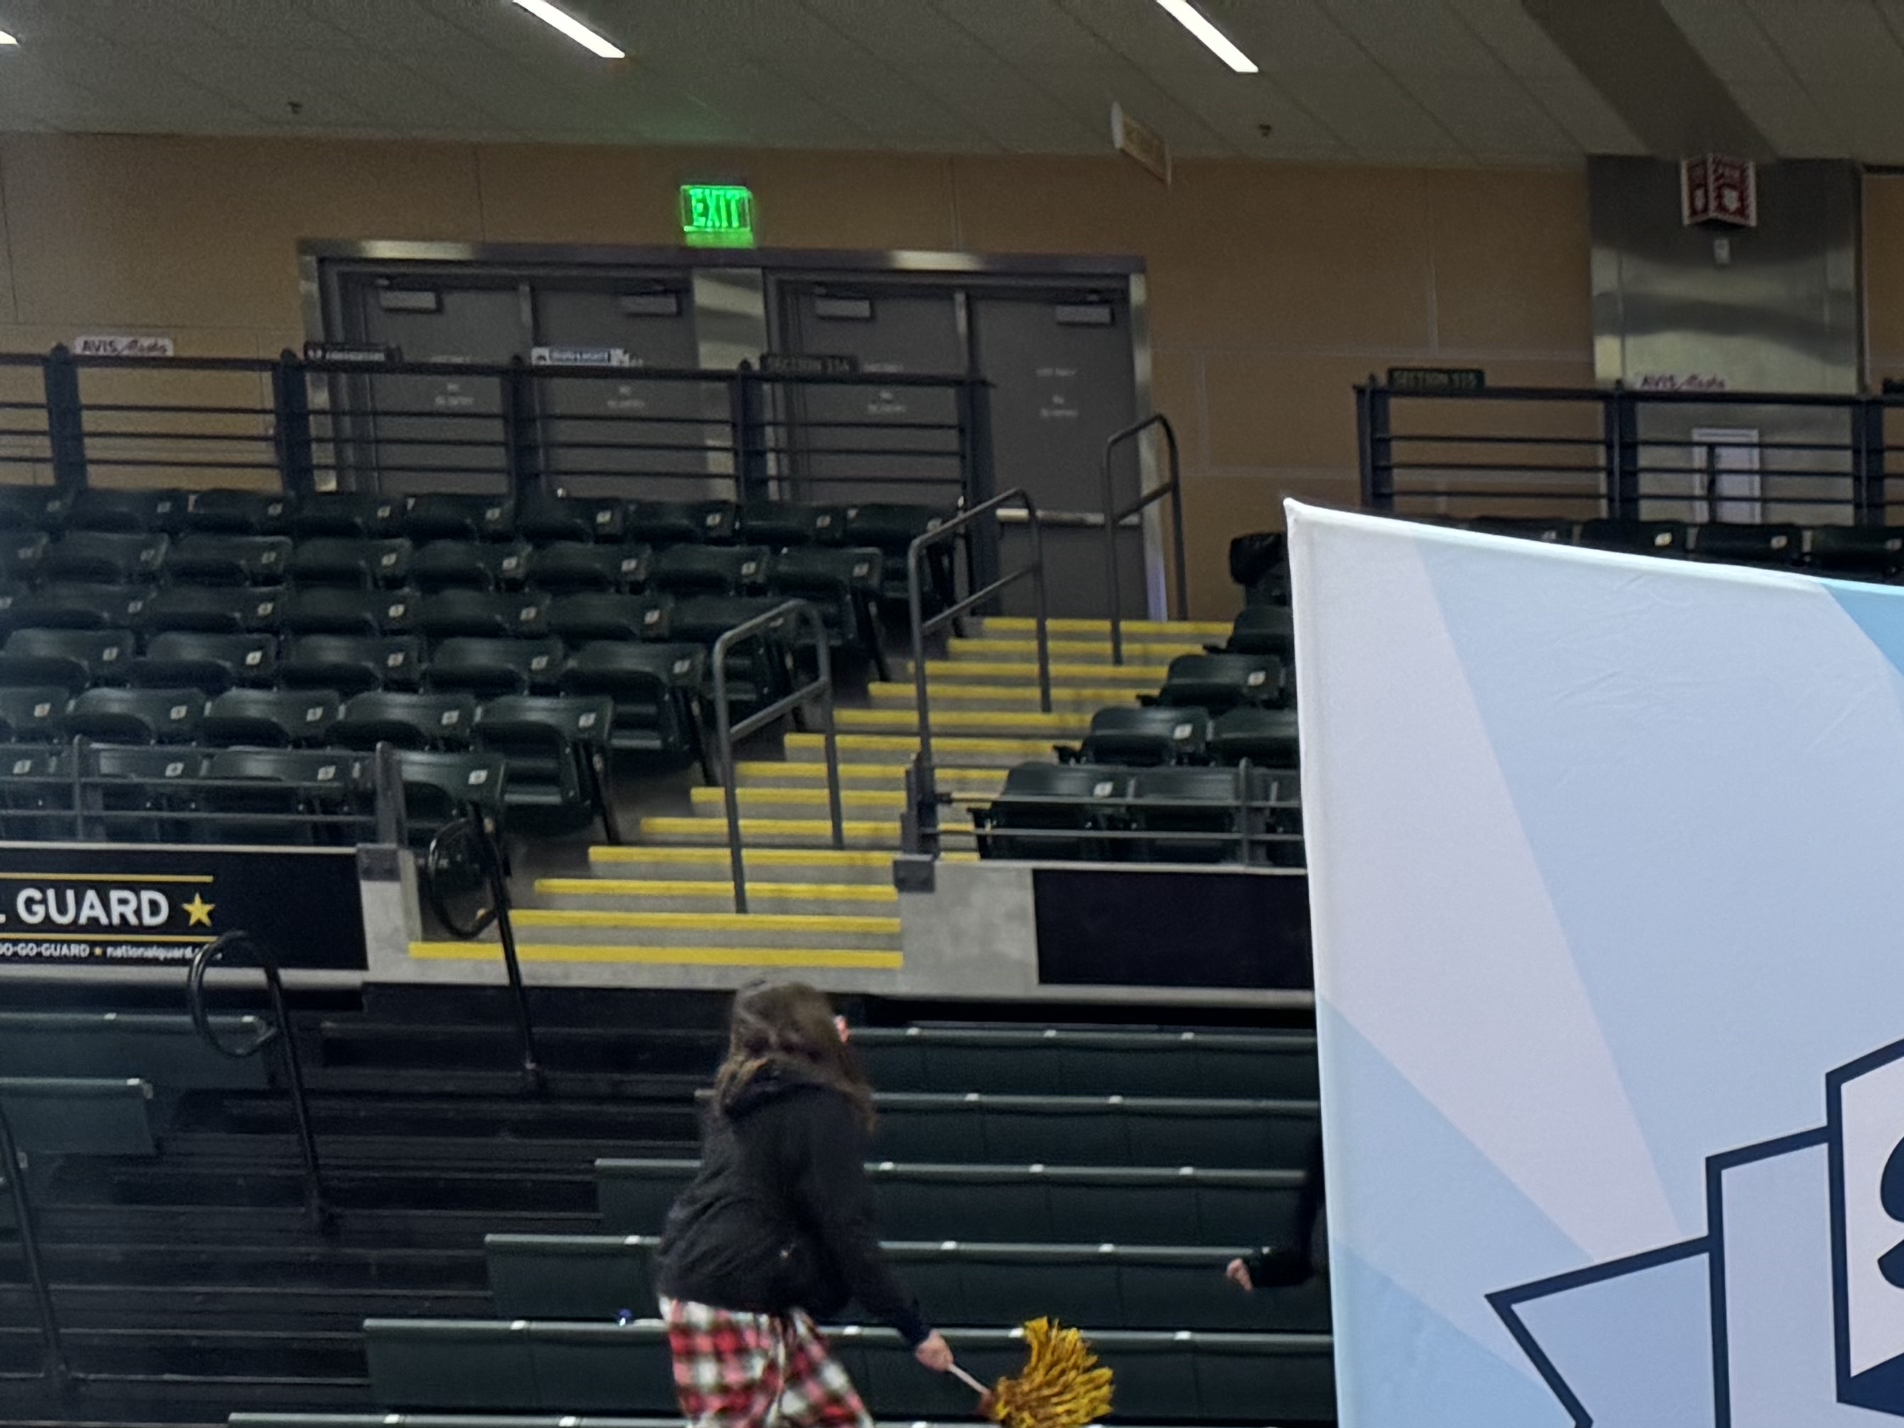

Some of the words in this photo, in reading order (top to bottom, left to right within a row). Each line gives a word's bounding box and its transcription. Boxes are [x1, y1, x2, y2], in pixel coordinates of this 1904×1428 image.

[689, 188, 744, 228] EXIT
[82, 340, 118, 353] AVIS
[16, 887, 170, 927] GUARD
